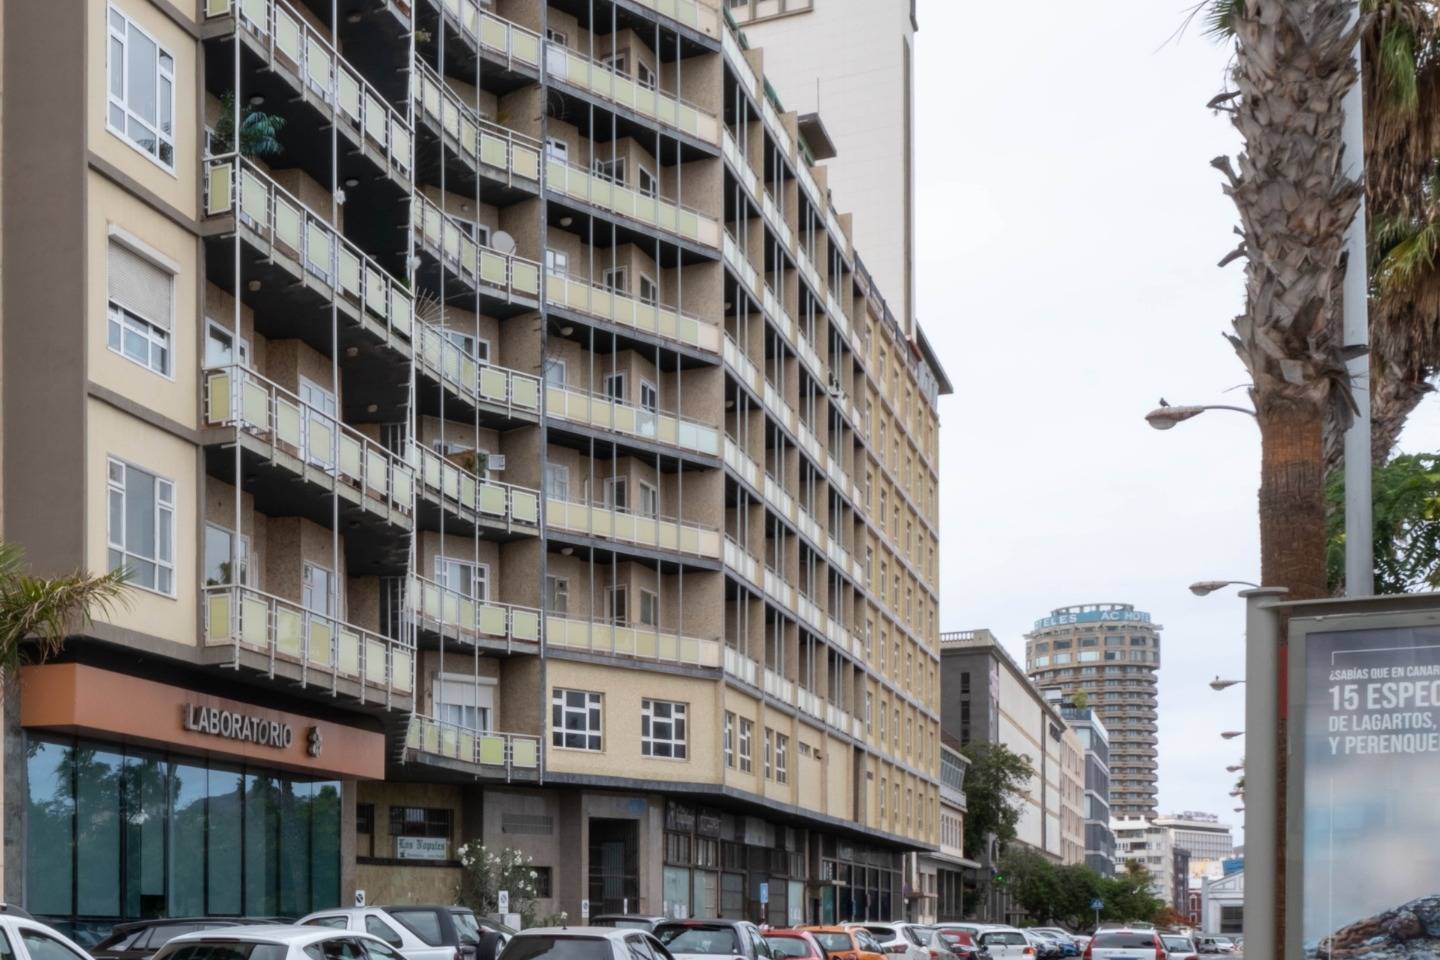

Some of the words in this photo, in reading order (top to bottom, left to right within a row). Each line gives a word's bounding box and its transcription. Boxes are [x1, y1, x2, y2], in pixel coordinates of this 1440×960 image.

[1101, 610, 1120, 621] AC
[1329, 667, 1368, 681] ¿SABÍAS
[1371, 668, 1389, 679] QUE
[1392, 667, 1404, 678] EN
[1329, 684, 1359, 711] 15
[186, 703, 293, 748] LABORATORIO
[1329, 716, 1348, 732] DE
[1352, 711, 1437, 731] LAGARTOS,
[1329, 736, 1340, 755] Y
[1345, 733, 1440, 754] PERENQUE
